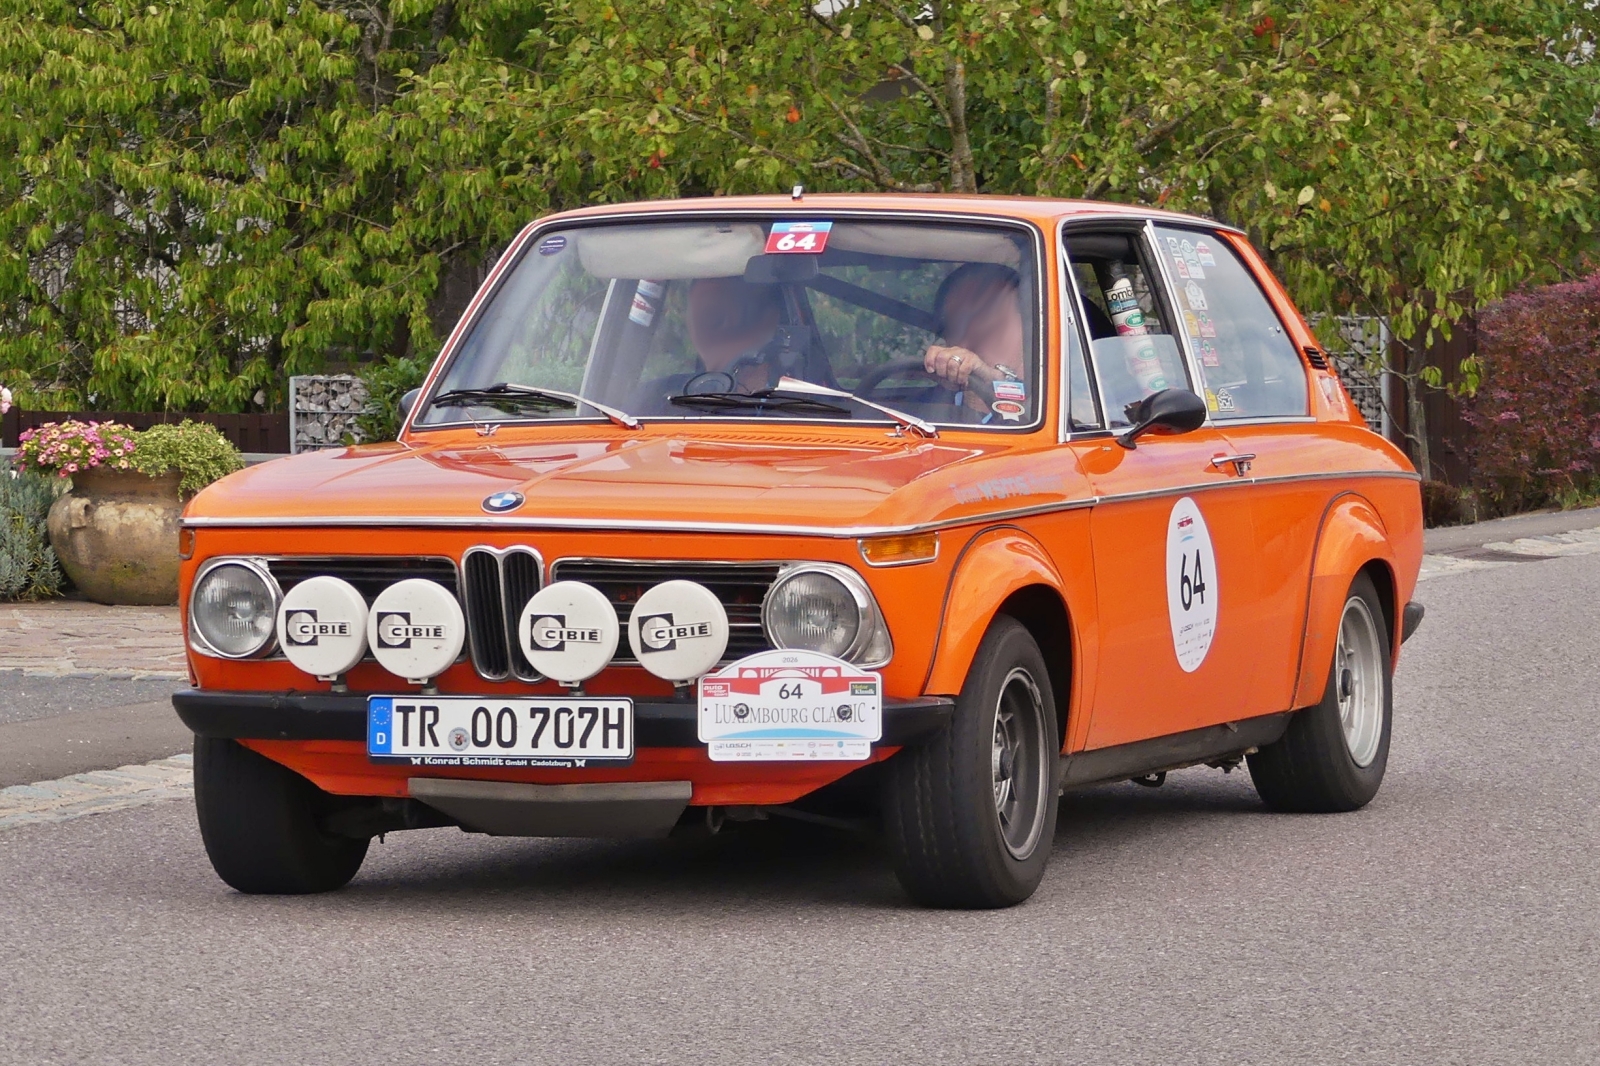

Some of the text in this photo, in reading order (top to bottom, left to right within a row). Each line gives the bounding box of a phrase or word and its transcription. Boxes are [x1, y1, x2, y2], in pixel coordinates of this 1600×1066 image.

[776, 233, 816, 251] 64
[1180, 549, 1206, 611] 64
[778, 684, 803, 699] 64
[813, 702, 866, 723] CLAIC
[396, 705, 439, 747] TR
[530, 707, 625, 750] 707H
[376, 732, 386, 745] D
[425, 757, 460, 765] Konrad
[462, 757, 504, 766] Schmidt
[531, 760, 572, 768] Cadolzburg
